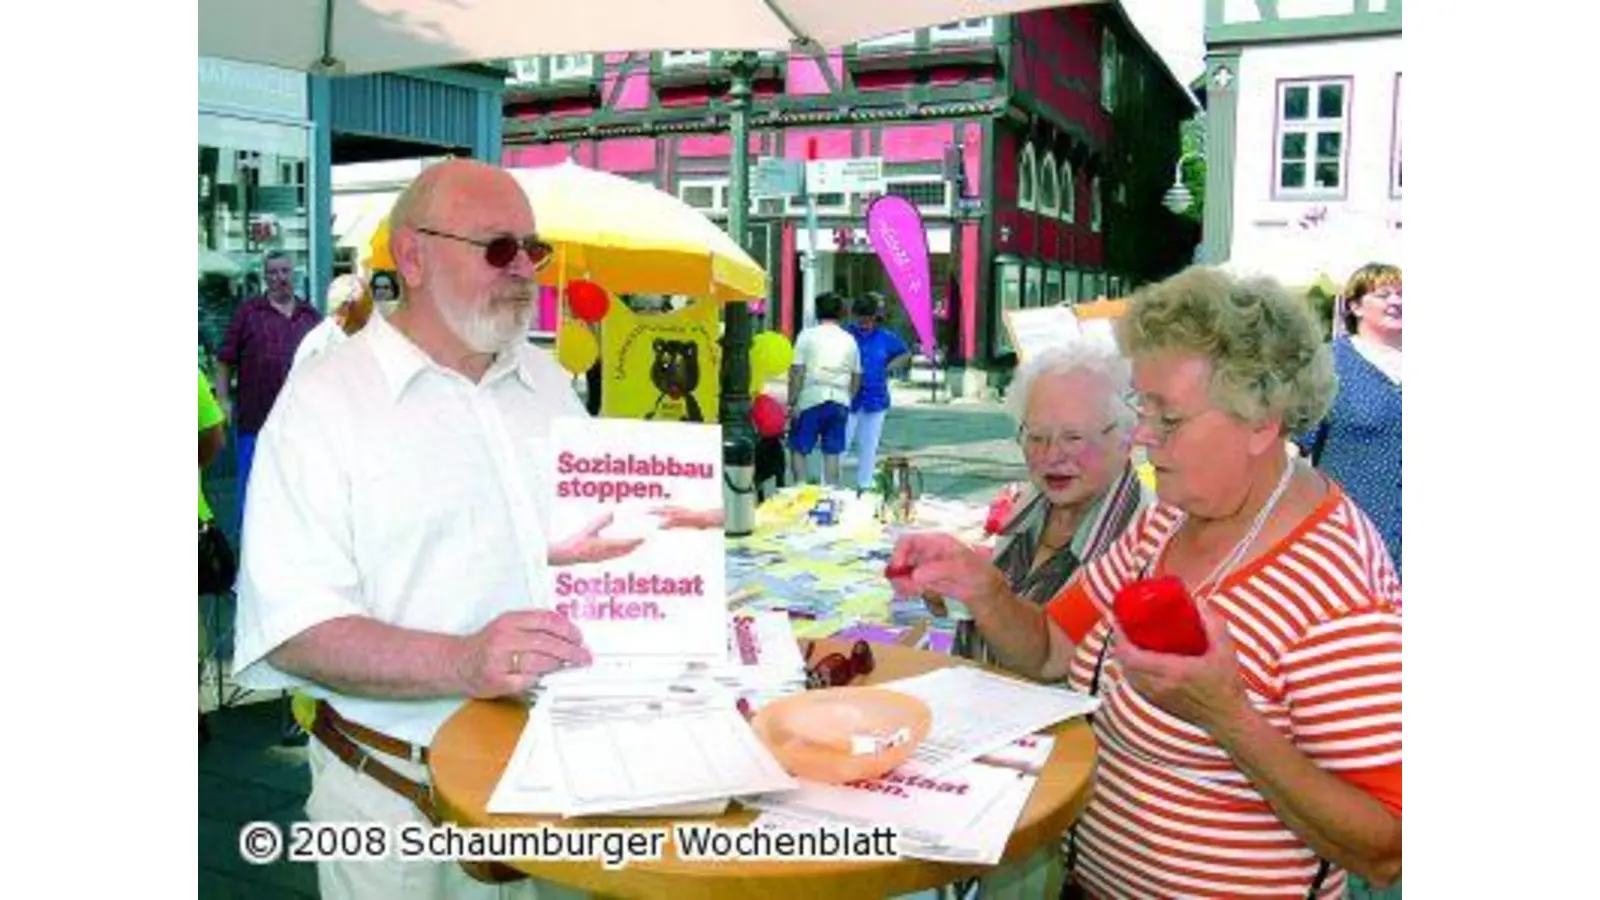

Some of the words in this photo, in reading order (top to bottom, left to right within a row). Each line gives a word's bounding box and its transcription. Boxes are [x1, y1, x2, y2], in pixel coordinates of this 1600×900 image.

[557, 452, 714, 479] Sozialabbau
[557, 478, 671, 503] stoppen.
[555, 572, 704, 596] Sozialstaat
[555, 596, 666, 620] stärken.
